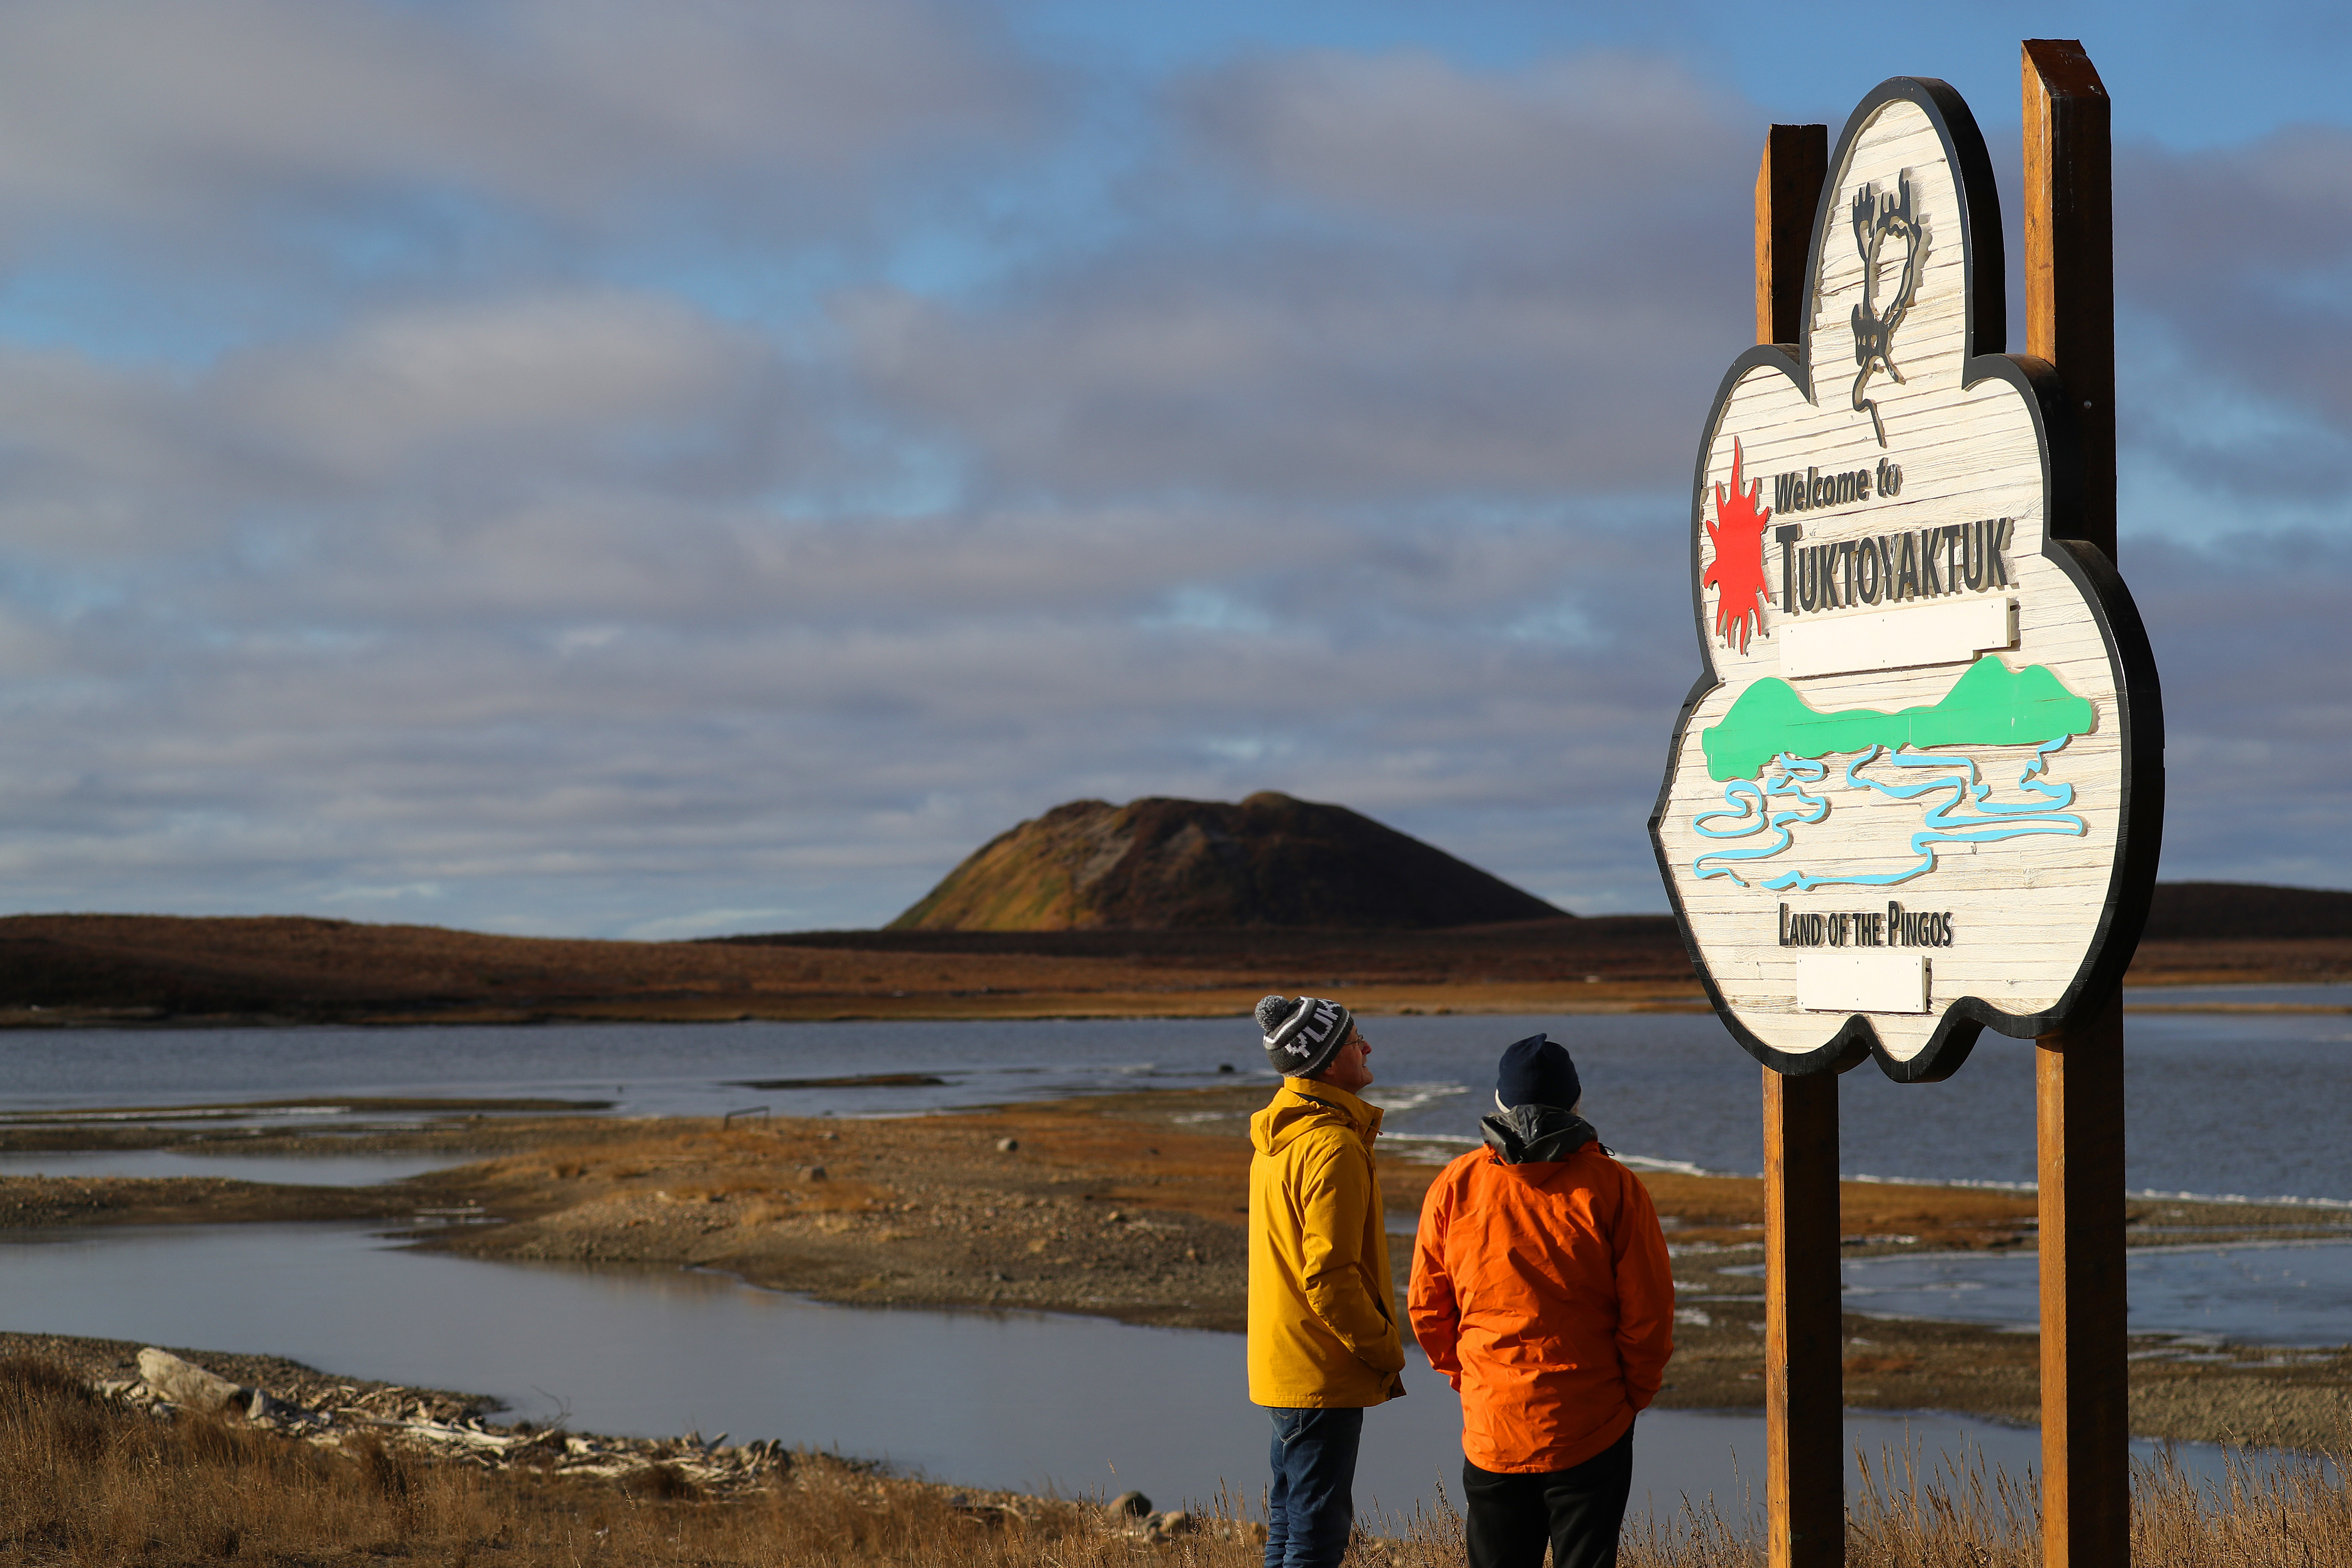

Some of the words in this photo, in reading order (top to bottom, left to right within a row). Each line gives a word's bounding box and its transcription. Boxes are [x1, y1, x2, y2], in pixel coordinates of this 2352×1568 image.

[1775, 466, 1868, 514] Welcome
[1877, 457, 1899, 497] to
[1776, 517, 2008, 613] TUKTOYAKTUK
[1779, 902, 1822, 946] LAND
[1828, 913, 1847, 946] OF
[1853, 913, 1882, 946] THE
[1888, 900, 1952, 946] PINGOS
[1285, 998, 1340, 1058] YUK
